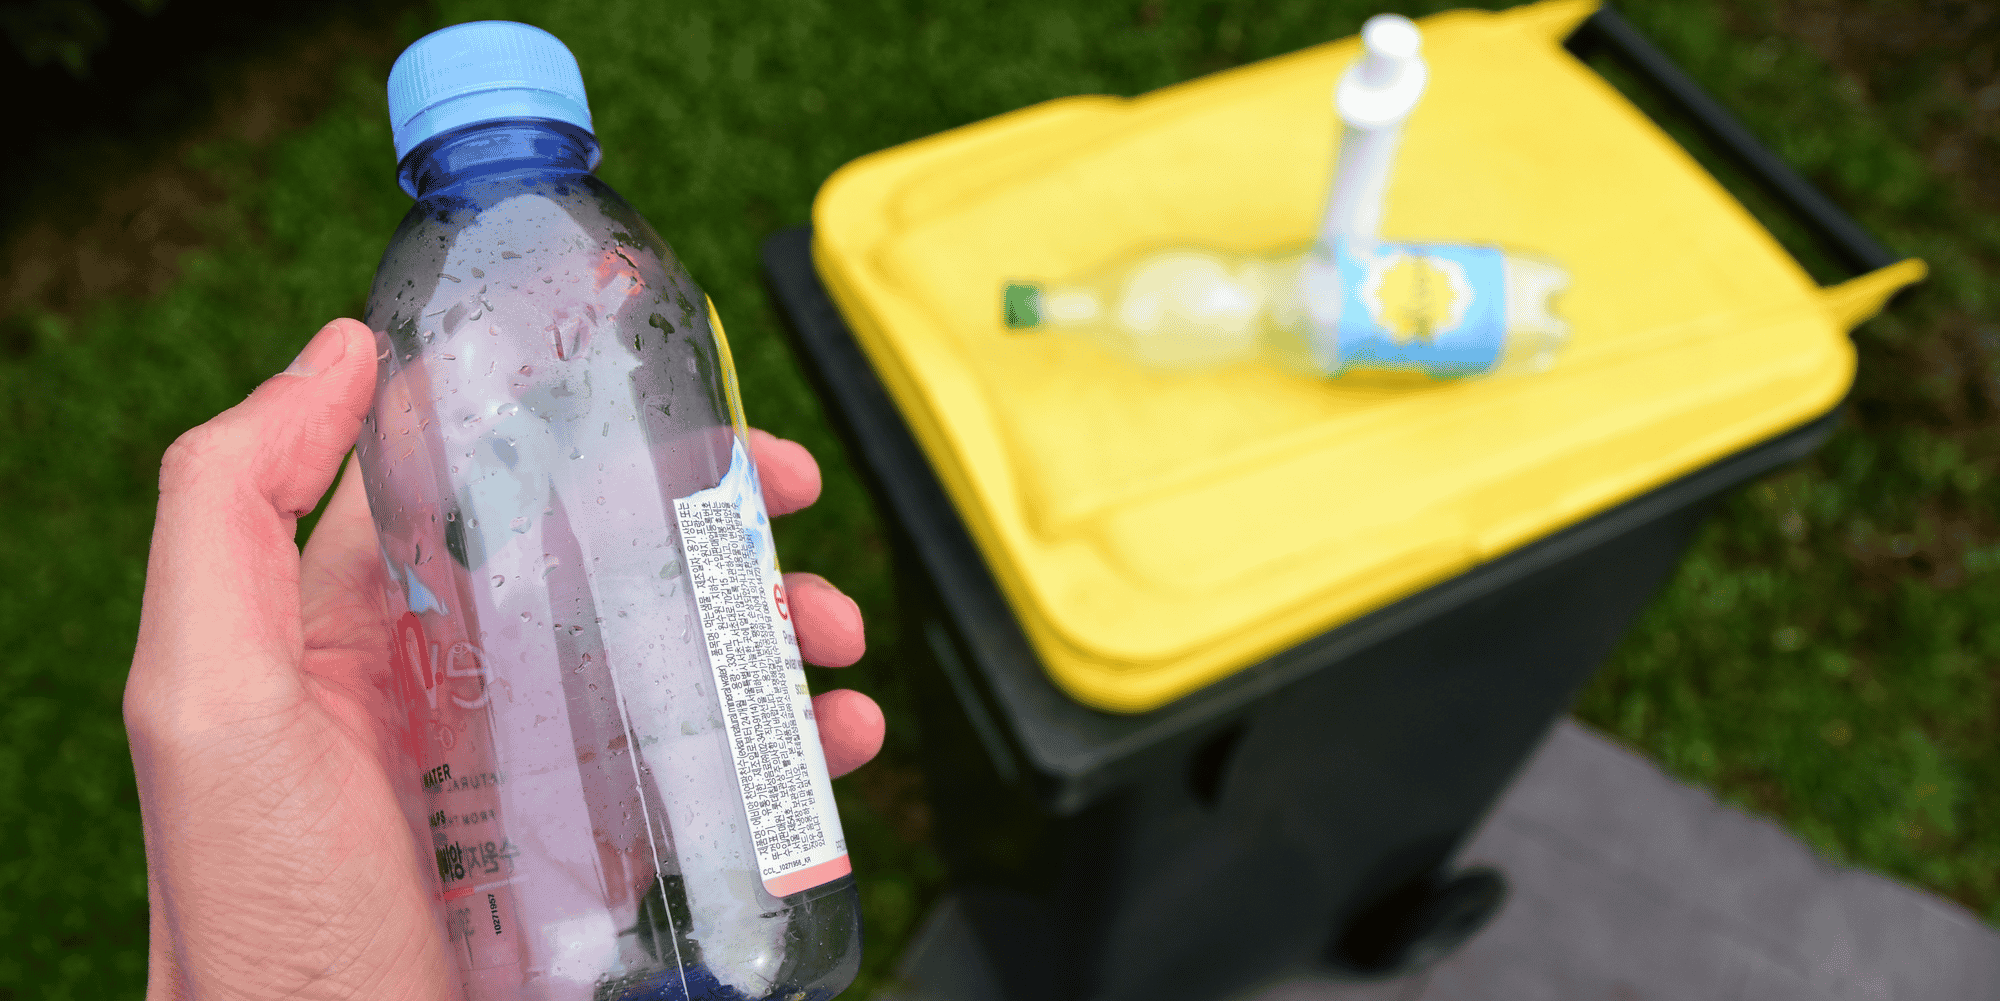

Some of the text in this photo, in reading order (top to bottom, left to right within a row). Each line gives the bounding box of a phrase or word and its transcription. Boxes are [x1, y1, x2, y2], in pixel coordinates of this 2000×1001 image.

[680, 503, 690, 517] 또는
[713, 503, 724, 523] 후에는
[717, 527, 727, 540] 개봉
[730, 541, 743, 571] 내용물이
[741, 545, 750, 558] 또는
[690, 558, 705, 588] 제조일자
[744, 562, 753, 575] 교환
[721, 589, 733, 604] 70길
[740, 574, 756, 618] 손상되었거나
[748, 579, 756, 592] 의거
[731, 586, 746, 608] 않도록
[699, 597, 714, 627] 먹는샘물
[726, 607, 740, 636] 서초대로
[737, 610, 748, 626] 얼지
[707, 633, 723, 656] 품목명
[741, 628, 752, 643] 곳에
[733, 639, 745, 661] 서초구
[745, 646, 757, 668] 서늘한
[759, 659, 770, 681] 용기가
[693, 512, 782, 860] 뚜껑표기 유통기한 제조일로부터 24개월 용량 330 mL 원수원 지하수 수원지 프랑스
[740, 664, 755, 701] 서울특별시
[751, 671, 763, 693] 피하여
[721, 688, 737, 712] mineral
[776, 697, 787, 718] 소비자
[728, 713, 740, 736] natural
[757, 697, 773, 734] 직사광선을
[774, 726, 786, 749] 드시기
[783, 722, 792, 744] 제품은
[768, 742, 782, 772] 주의사항
[780, 751, 791, 767] 빨리
[776, 775, 788, 797] 보관상
[785, 769, 800, 808] 보관하시고
[747, 801, 761, 825] 에비앙
[785, 808, 796, 831] 제54호
[794, 811, 804, 826] 냉장
[801, 800, 814, 830] 음용하지
[754, 830, 768, 855] 제품명
[790, 835, 800, 849] 서울
[798, 827, 811, 851] 반드시
[809, 834, 818, 847] 경우
